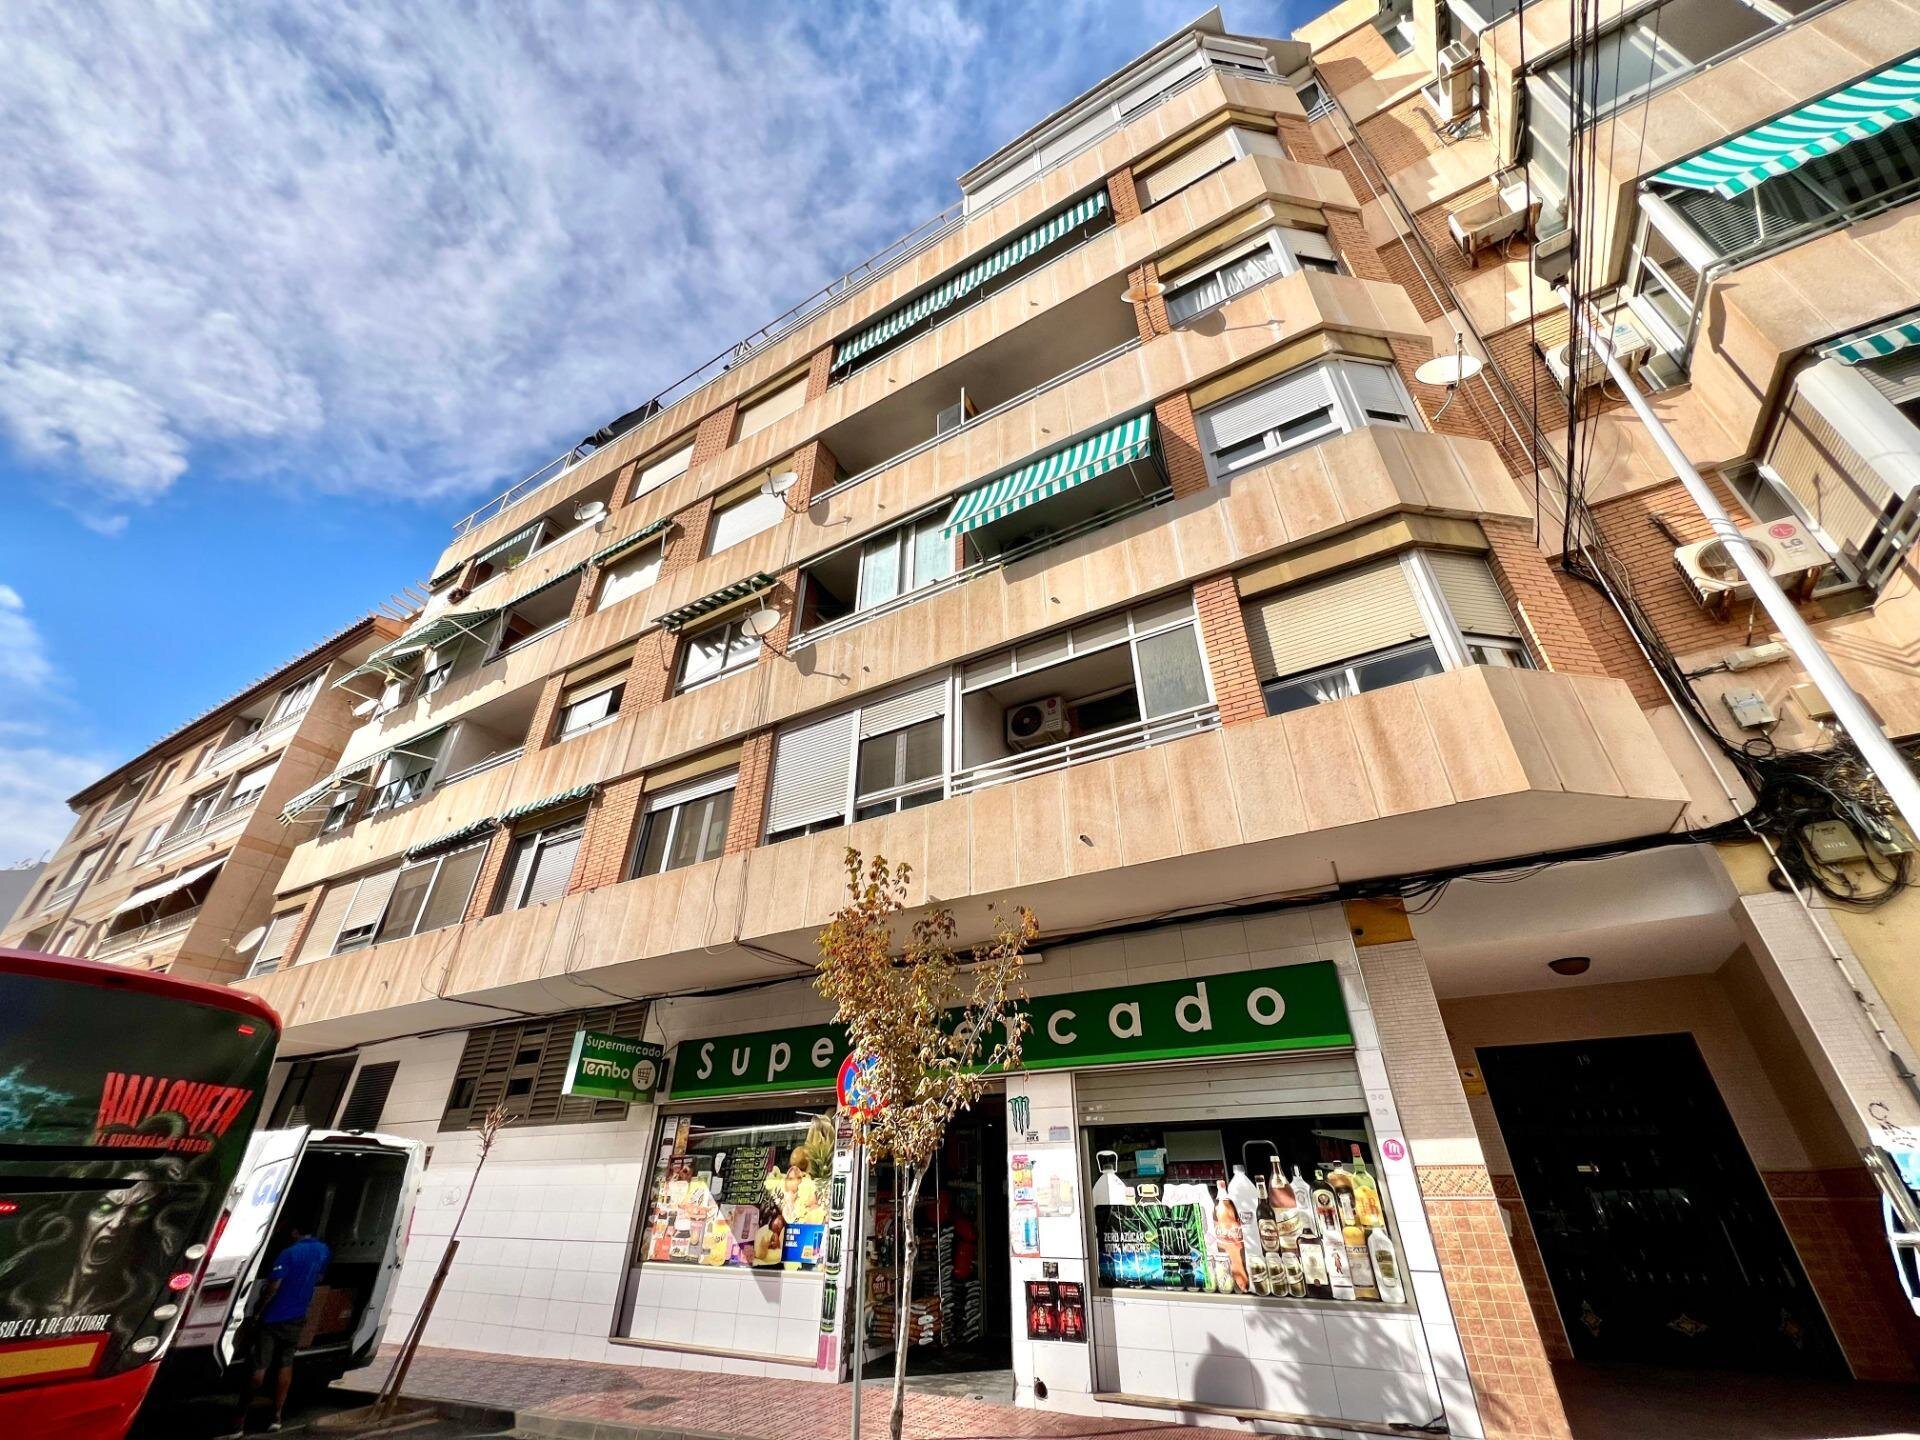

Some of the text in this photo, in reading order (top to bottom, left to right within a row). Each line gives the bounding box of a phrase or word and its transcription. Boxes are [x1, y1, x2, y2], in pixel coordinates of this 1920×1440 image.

[1780, 538, 1804, 549] LG
[696, 981, 1286, 1083] Supeercado
[585, 1035, 662, 1058] Supermercado
[582, 1057, 631, 1080] Tembo
[95, 1071, 254, 1140] HALLOWEEN
[20, 1319, 36, 1336] EL
[36, 1318, 47, 1334] 3
[46, 1316, 64, 1333] DE
[61, 1314, 111, 1332] OCTUBRE
